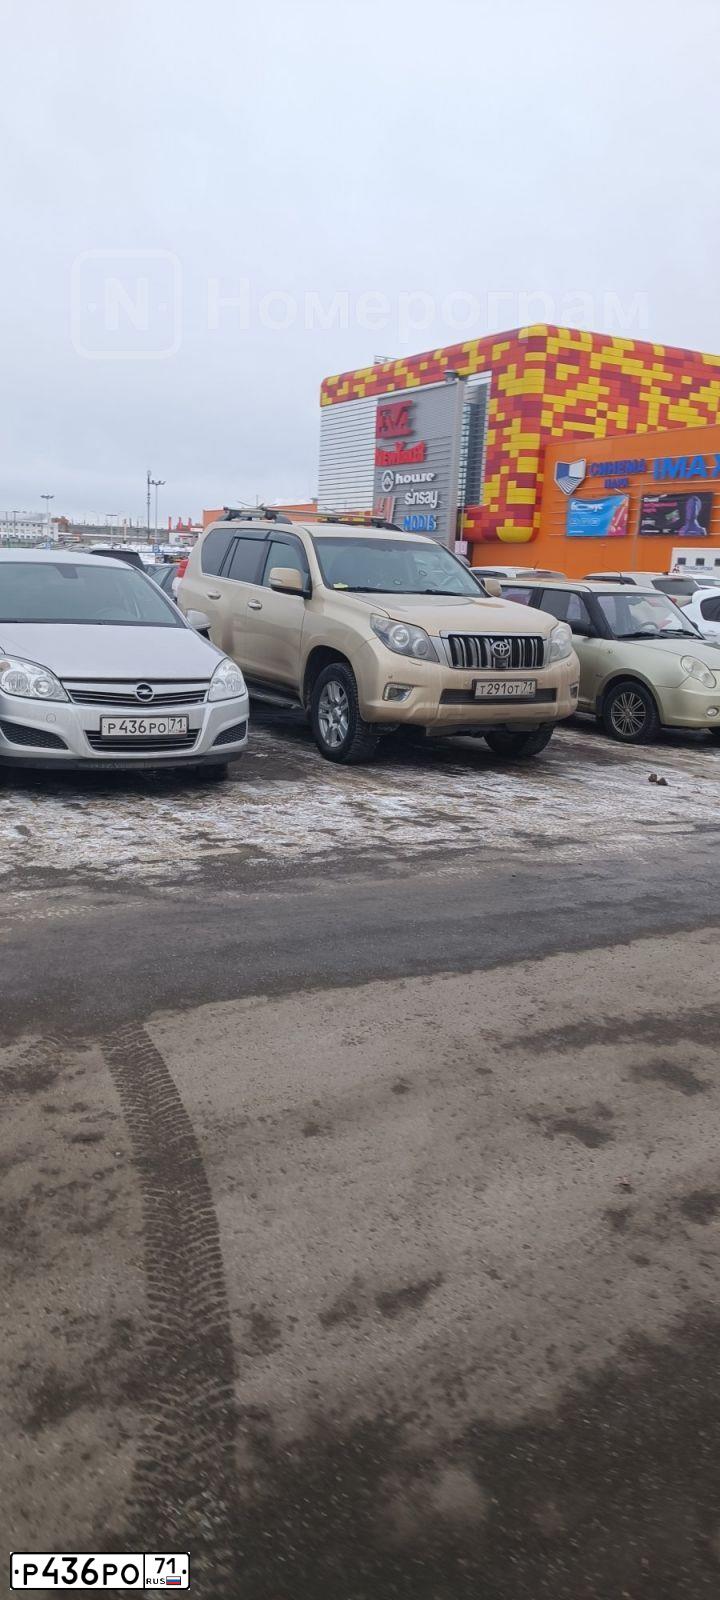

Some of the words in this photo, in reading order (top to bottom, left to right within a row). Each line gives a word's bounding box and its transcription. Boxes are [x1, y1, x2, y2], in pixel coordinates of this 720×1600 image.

[395, 472, 435, 484] house
[404, 488, 438, 508] sinsay
[170, 718, 183, 729] 71
